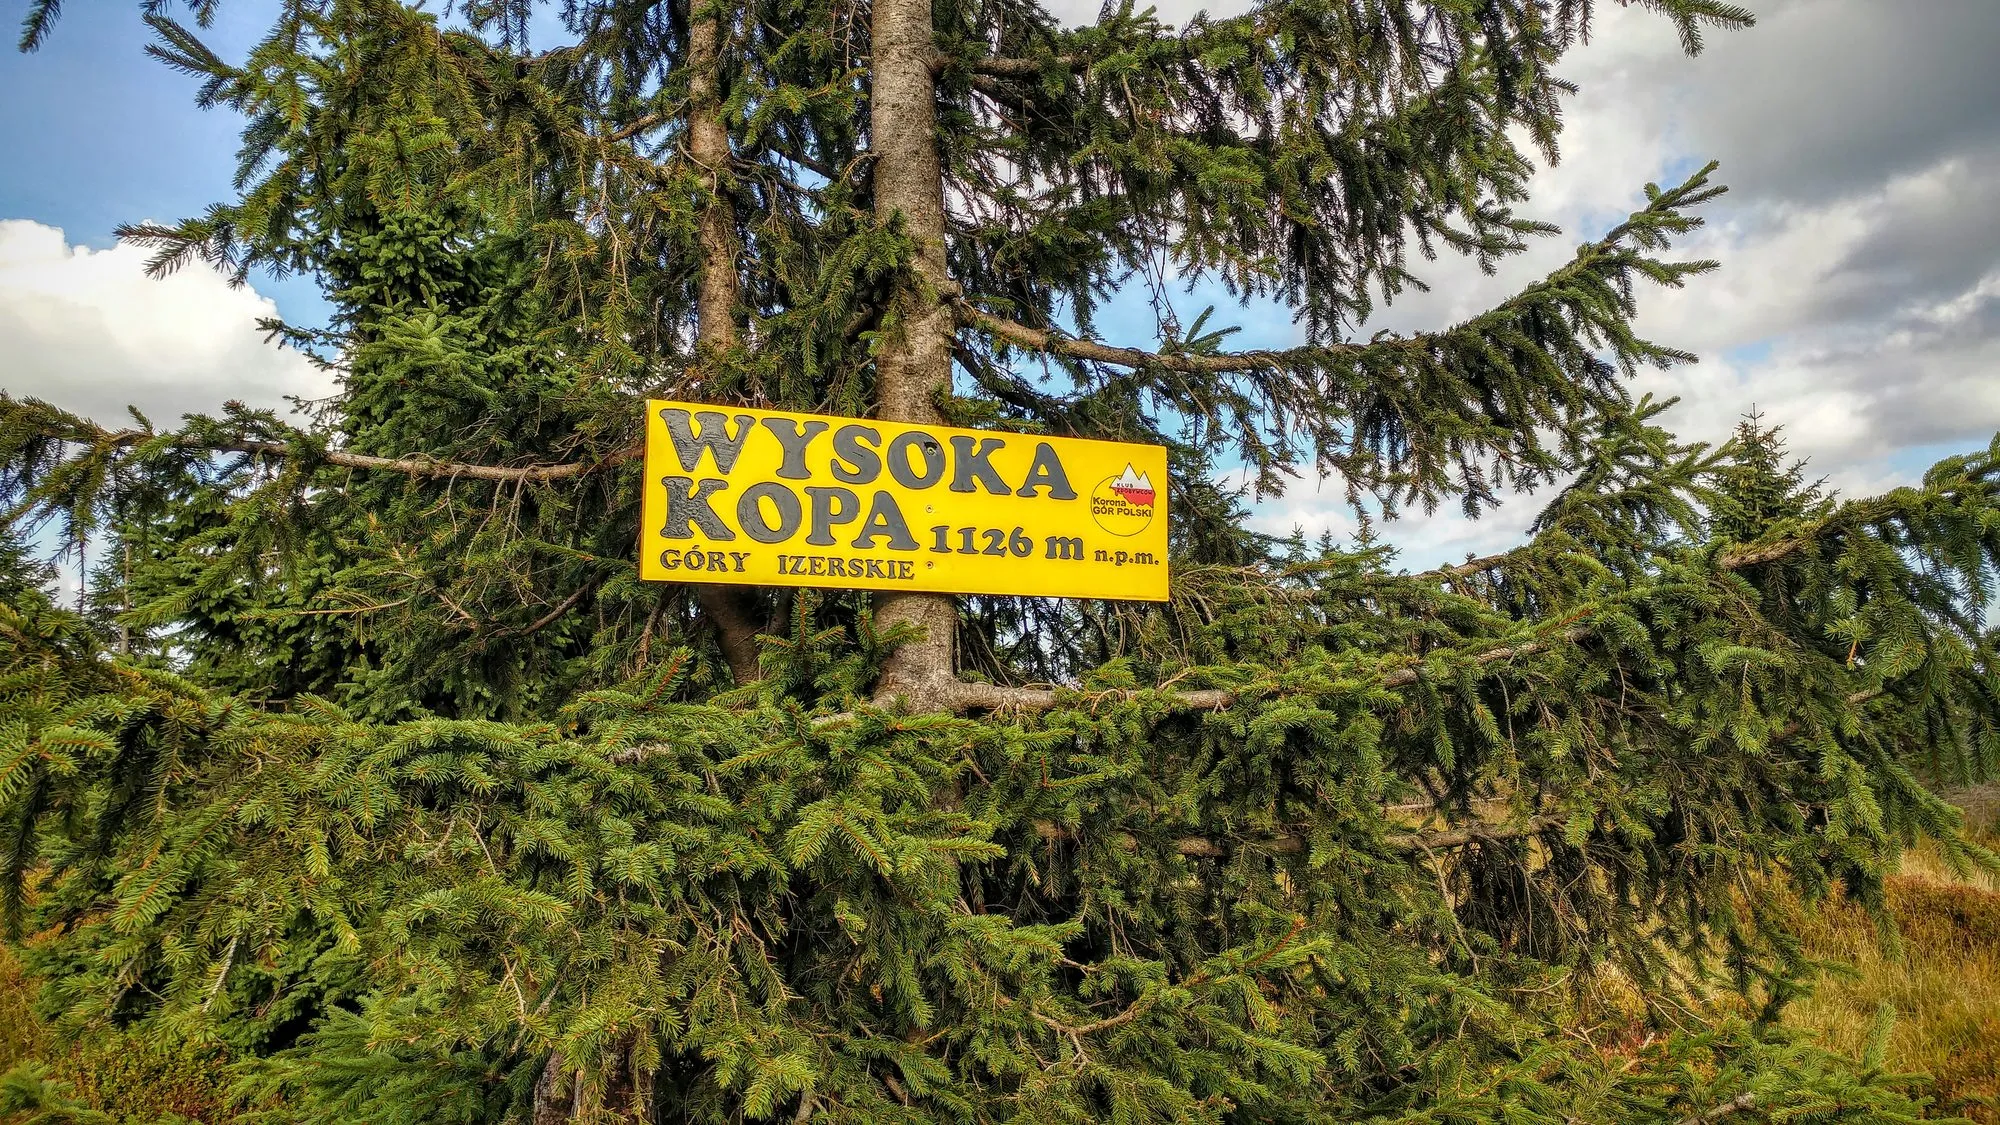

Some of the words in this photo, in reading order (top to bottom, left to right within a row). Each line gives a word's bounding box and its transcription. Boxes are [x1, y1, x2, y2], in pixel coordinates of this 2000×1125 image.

[659, 408, 1078, 501] WYSOKA
[1092, 496, 1127, 507] Korona
[1093, 505, 1115, 515] GÓR
[1117, 507, 1152, 517] POLSKI
[660, 475, 921, 551] KOPA
[929, 525, 1034, 558] 1126
[1045, 535, 1085, 561] m
[1094, 549, 1160, 567] n.p.m.
[659, 545, 751, 573] GÓRY
[777, 554, 916, 580] IZERSKIE
